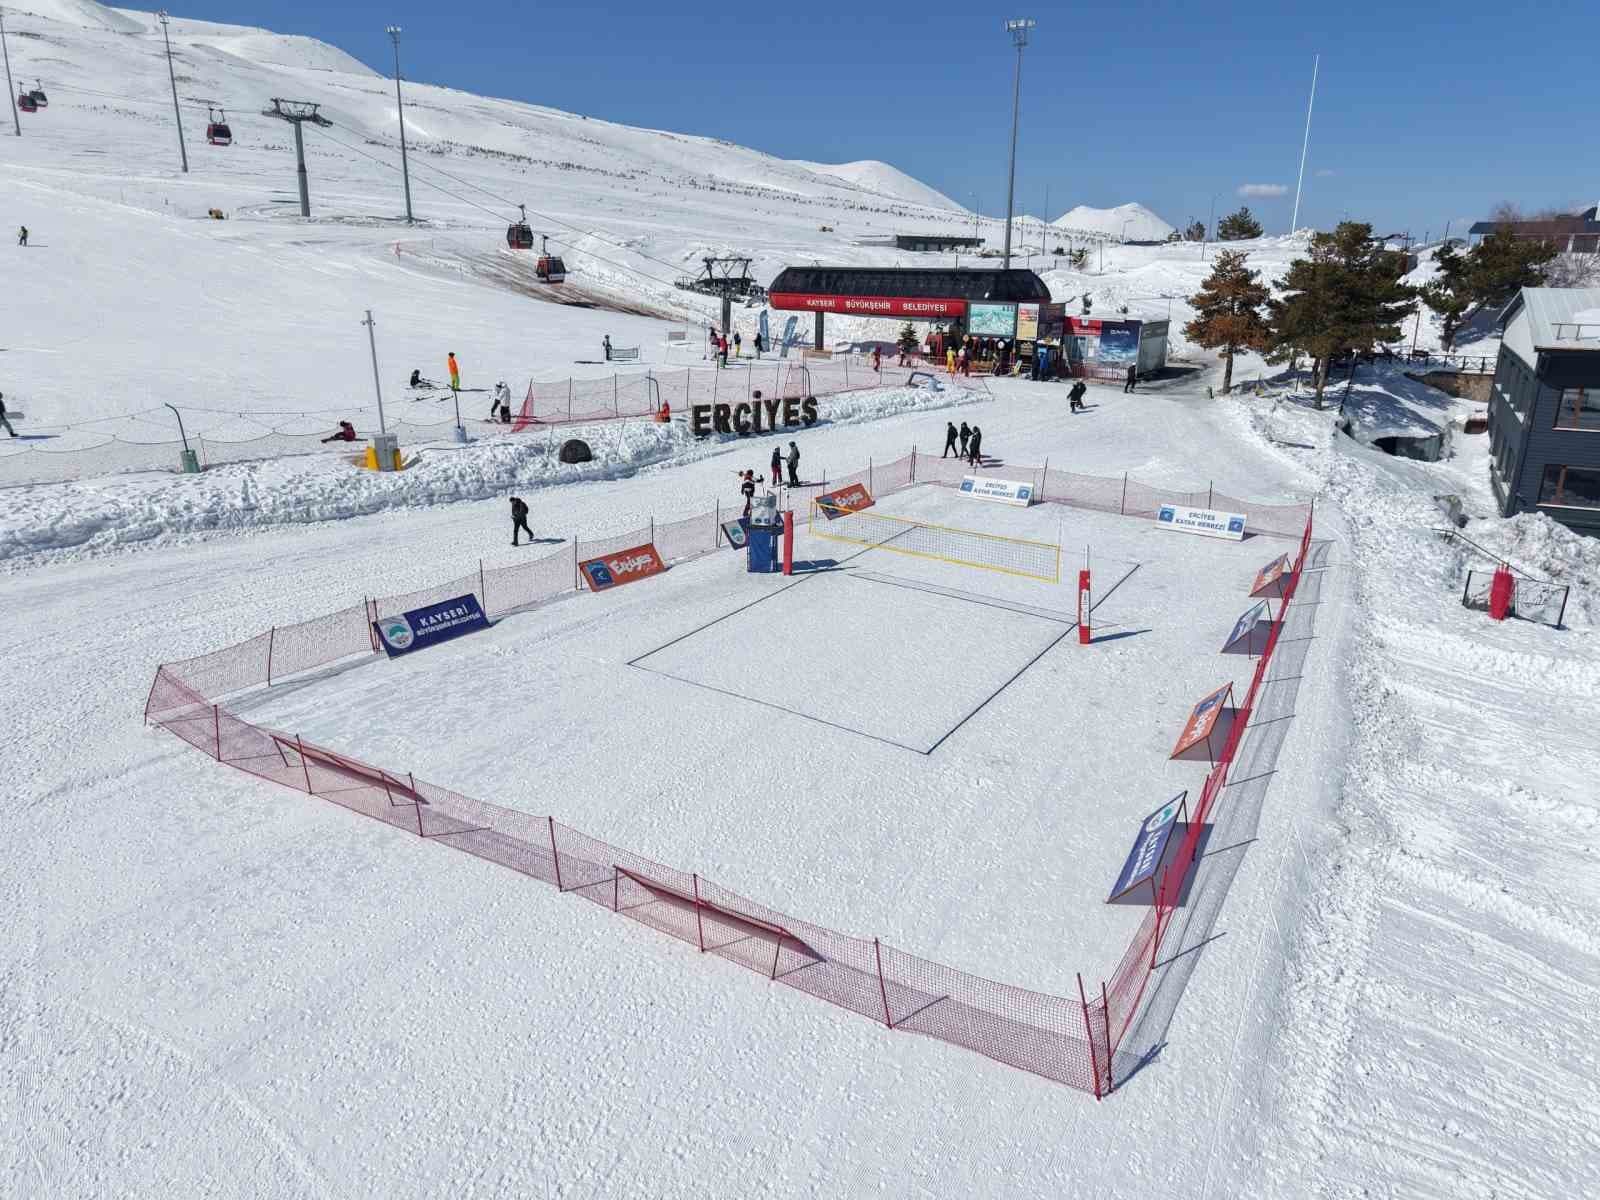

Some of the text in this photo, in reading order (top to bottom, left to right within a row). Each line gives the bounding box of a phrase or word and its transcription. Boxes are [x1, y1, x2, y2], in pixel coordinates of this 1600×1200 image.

[845, 299, 891, 311] BÜYÜKŞEHİR
[902, 301, 947, 312] BELEDİYESİ
[692, 390, 818, 437] ERCİYES
[419, 604, 469, 627] KAYSERİ
